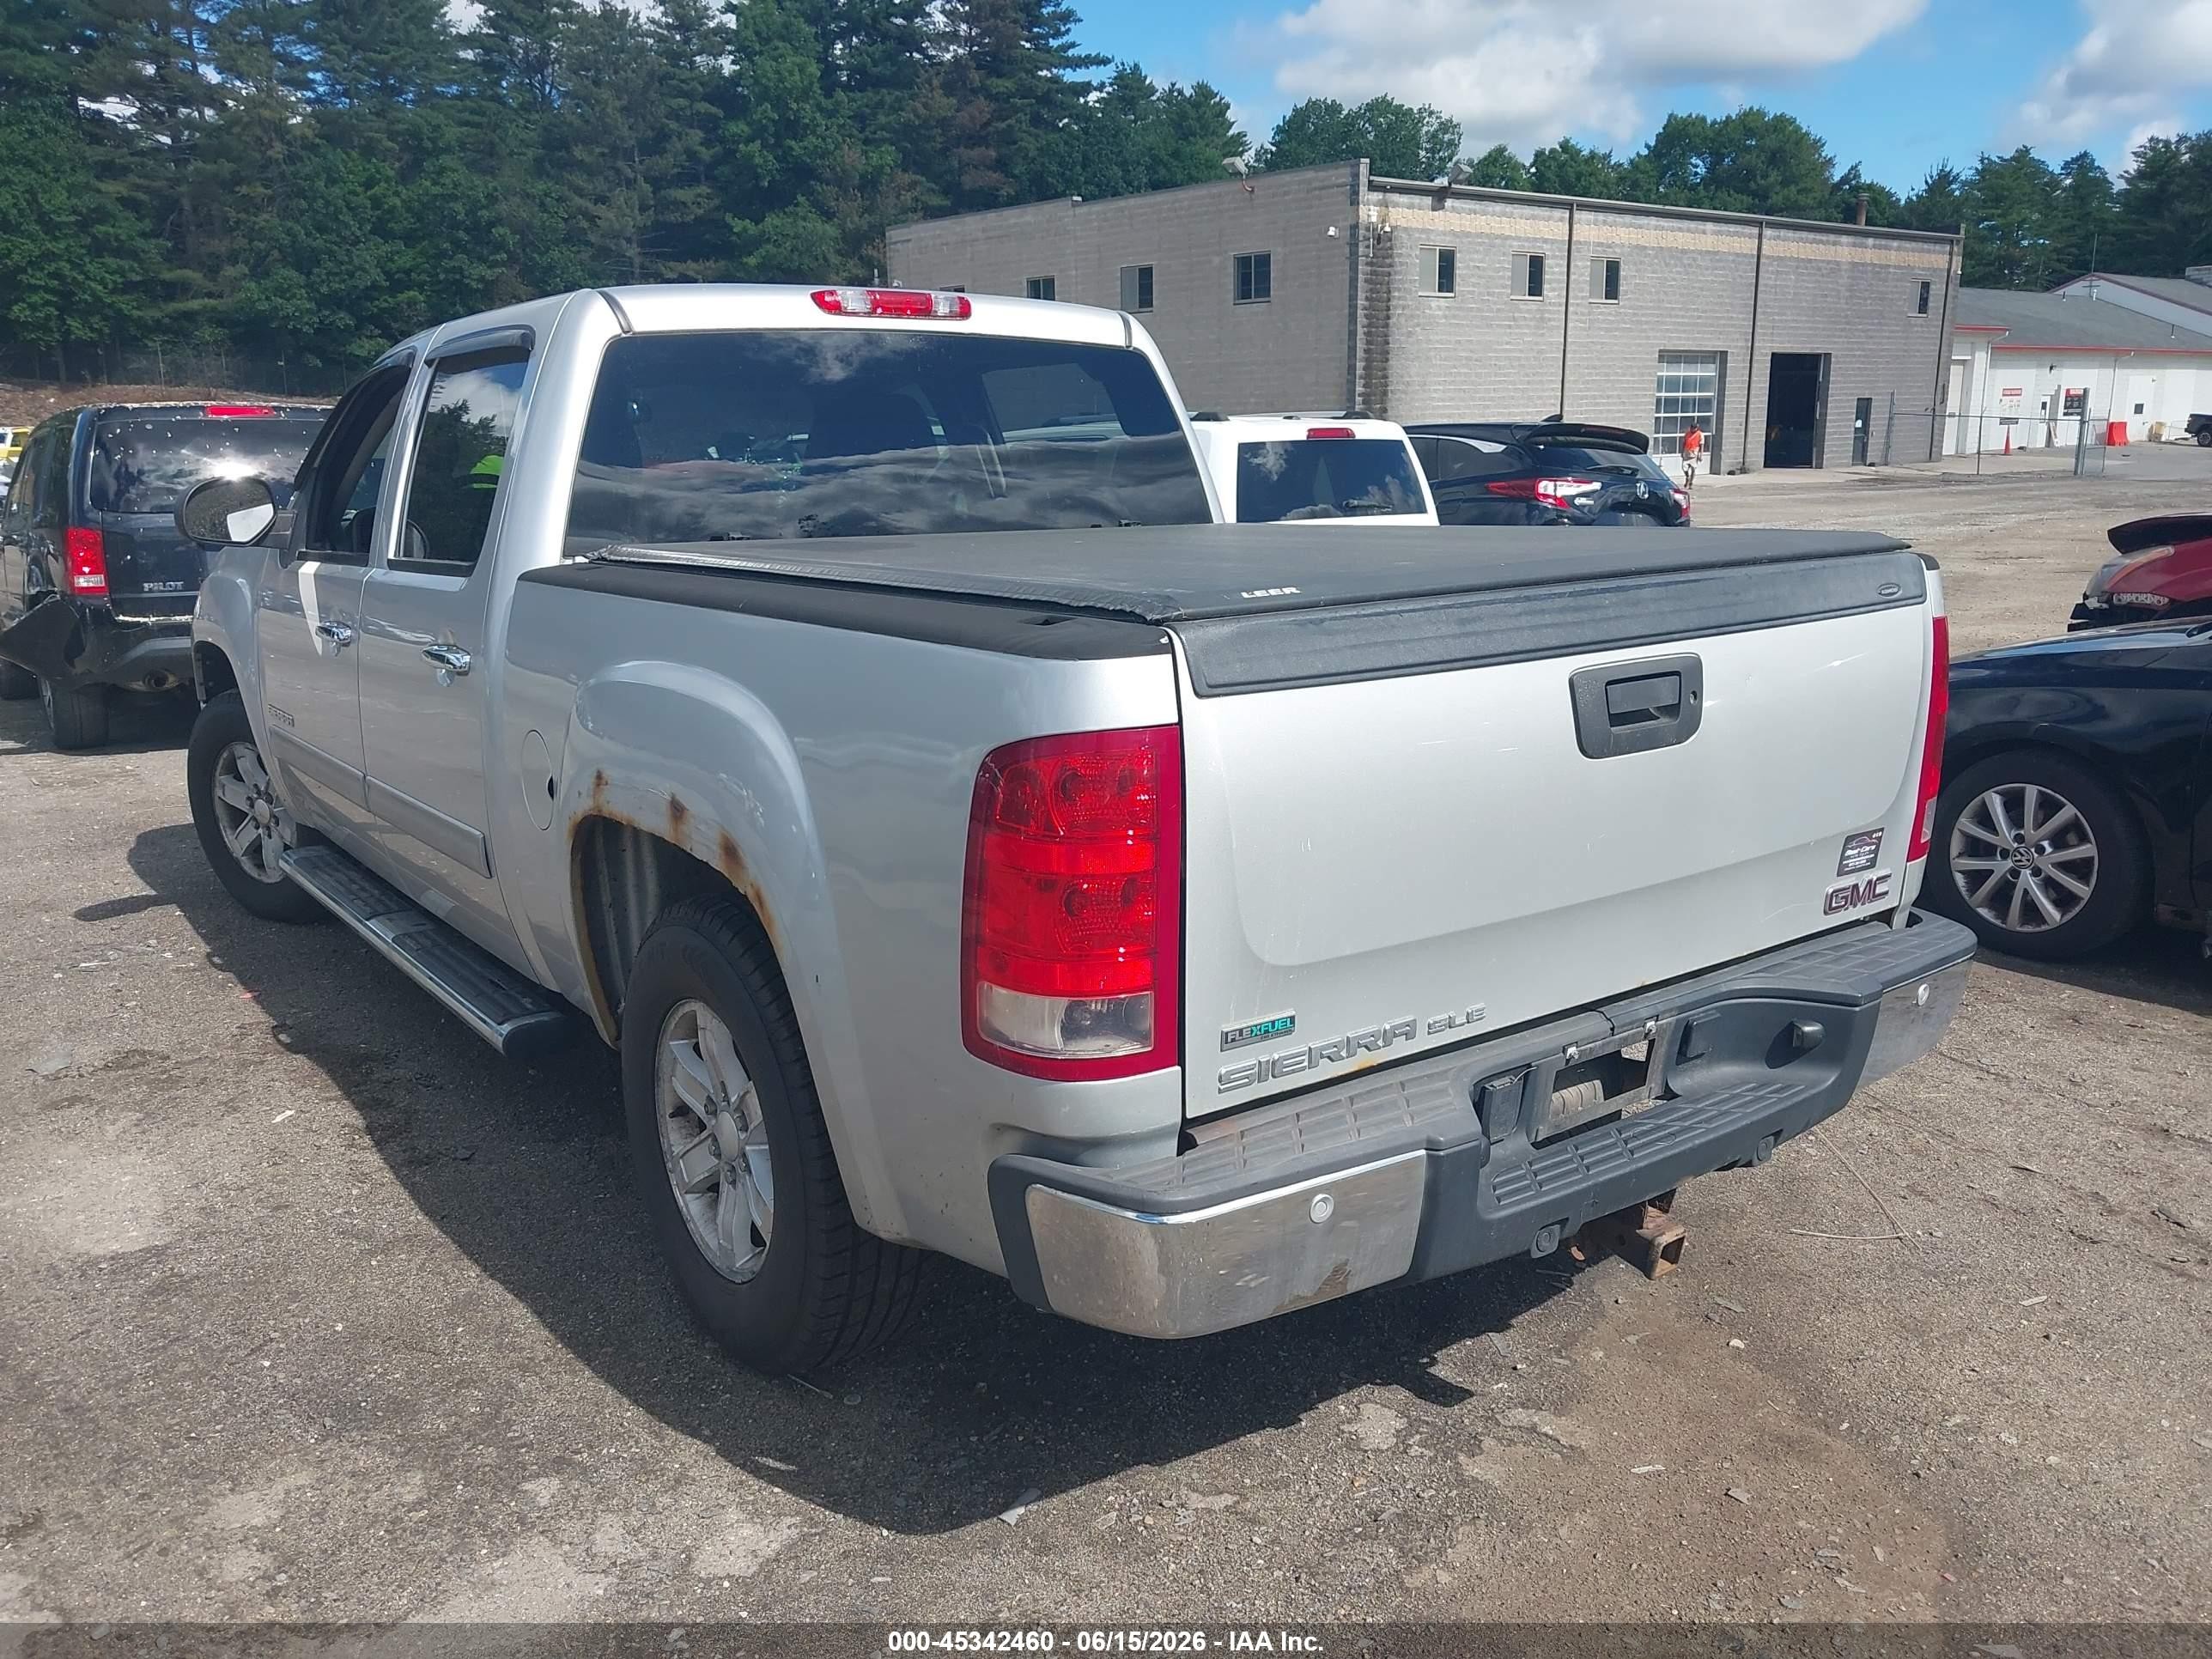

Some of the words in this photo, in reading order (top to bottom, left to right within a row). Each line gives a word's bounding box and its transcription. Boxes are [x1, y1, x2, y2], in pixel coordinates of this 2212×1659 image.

[143, 581, 184, 592] PILOT
[1240, 586, 1301, 599] LEER
[1824, 872, 1893, 916] GMC
[1224, 1016, 1295, 1044] FLEXFUEL
[1218, 1015, 1417, 1095] SIERRA
[1427, 1003, 1486, 1036] SLE
